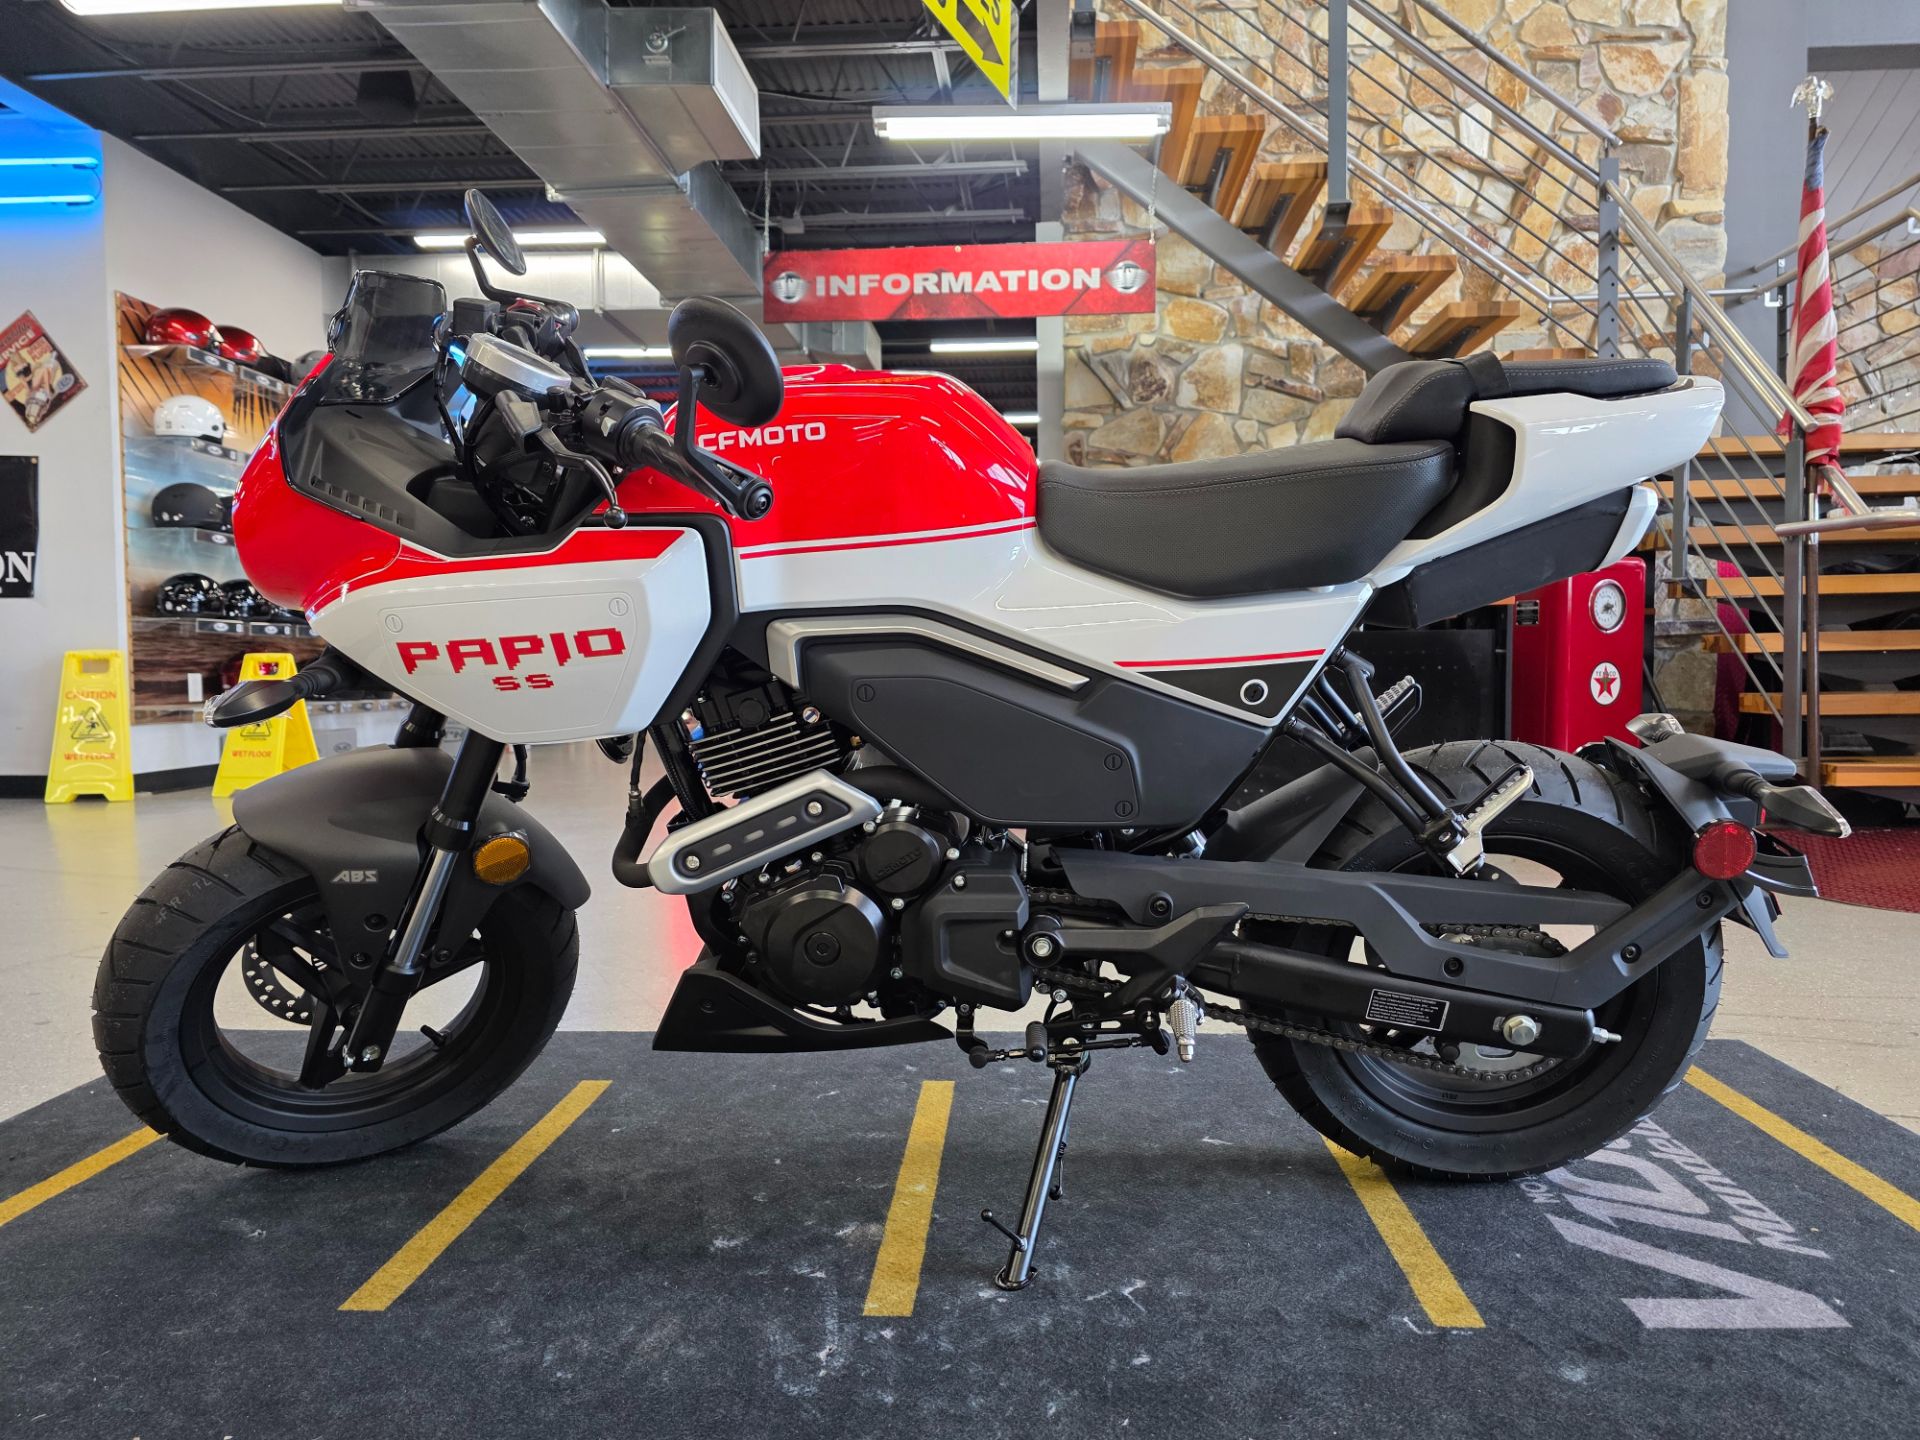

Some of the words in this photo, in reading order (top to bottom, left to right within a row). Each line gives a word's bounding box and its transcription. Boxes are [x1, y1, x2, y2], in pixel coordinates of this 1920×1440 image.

[815, 266, 1101, 297] INFORMATION
[697, 421, 826, 451] CFMOTO
[396, 627, 626, 675] PAPIO
[491, 673, 555, 691] SS
[331, 870, 378, 883] ABS
